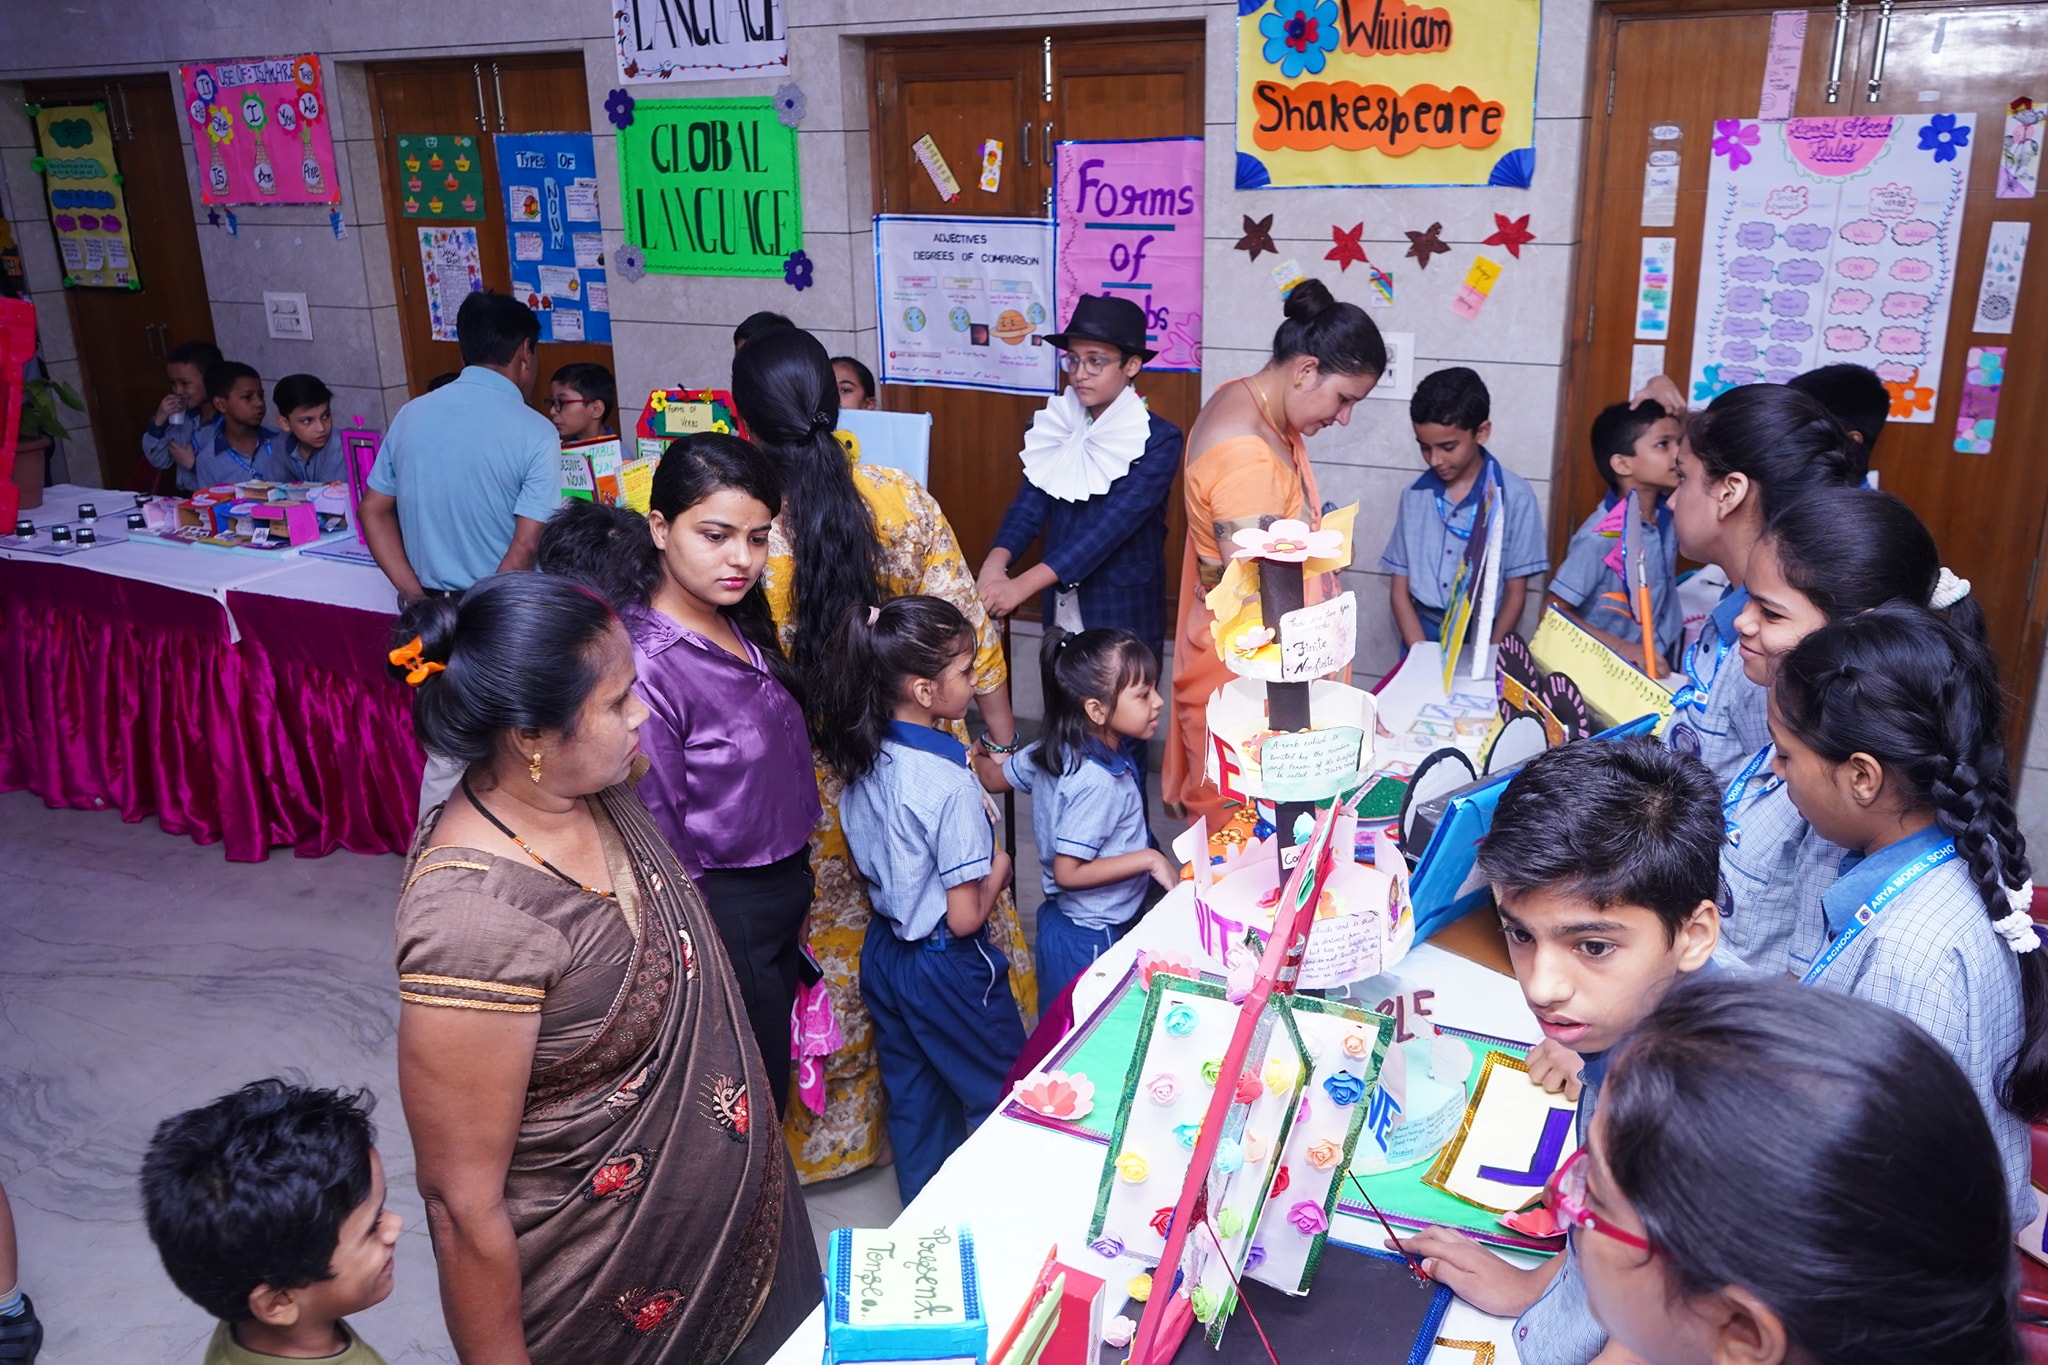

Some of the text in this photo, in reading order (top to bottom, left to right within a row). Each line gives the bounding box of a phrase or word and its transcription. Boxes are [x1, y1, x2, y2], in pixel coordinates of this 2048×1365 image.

[1341, 0, 1452, 50] William
[217, 66, 235, 86] USE
[246, 104, 260, 122] I
[1257, 84, 1502, 145] Shakespeare
[517, 151, 575, 168] TYPES OF
[651, 120, 768, 174] GLOBAL
[1075, 159, 1194, 217] Forms
[547, 182, 563, 250] NOUN
[636, 187, 790, 257] LANGUAGE
[933, 232, 987, 244] ADJECTIVES
[913, 250, 1040, 266] DEGREES OF COMPARISON
[1110, 235, 1155, 283] of
[1293, 636, 1327, 657] Finite
[1727, 781, 1745, 803] ODEL
[1870, 843, 1956, 910] ARYA MODEL SCHO
[1806, 927, 1857, 985] ODEL SCHOOL
